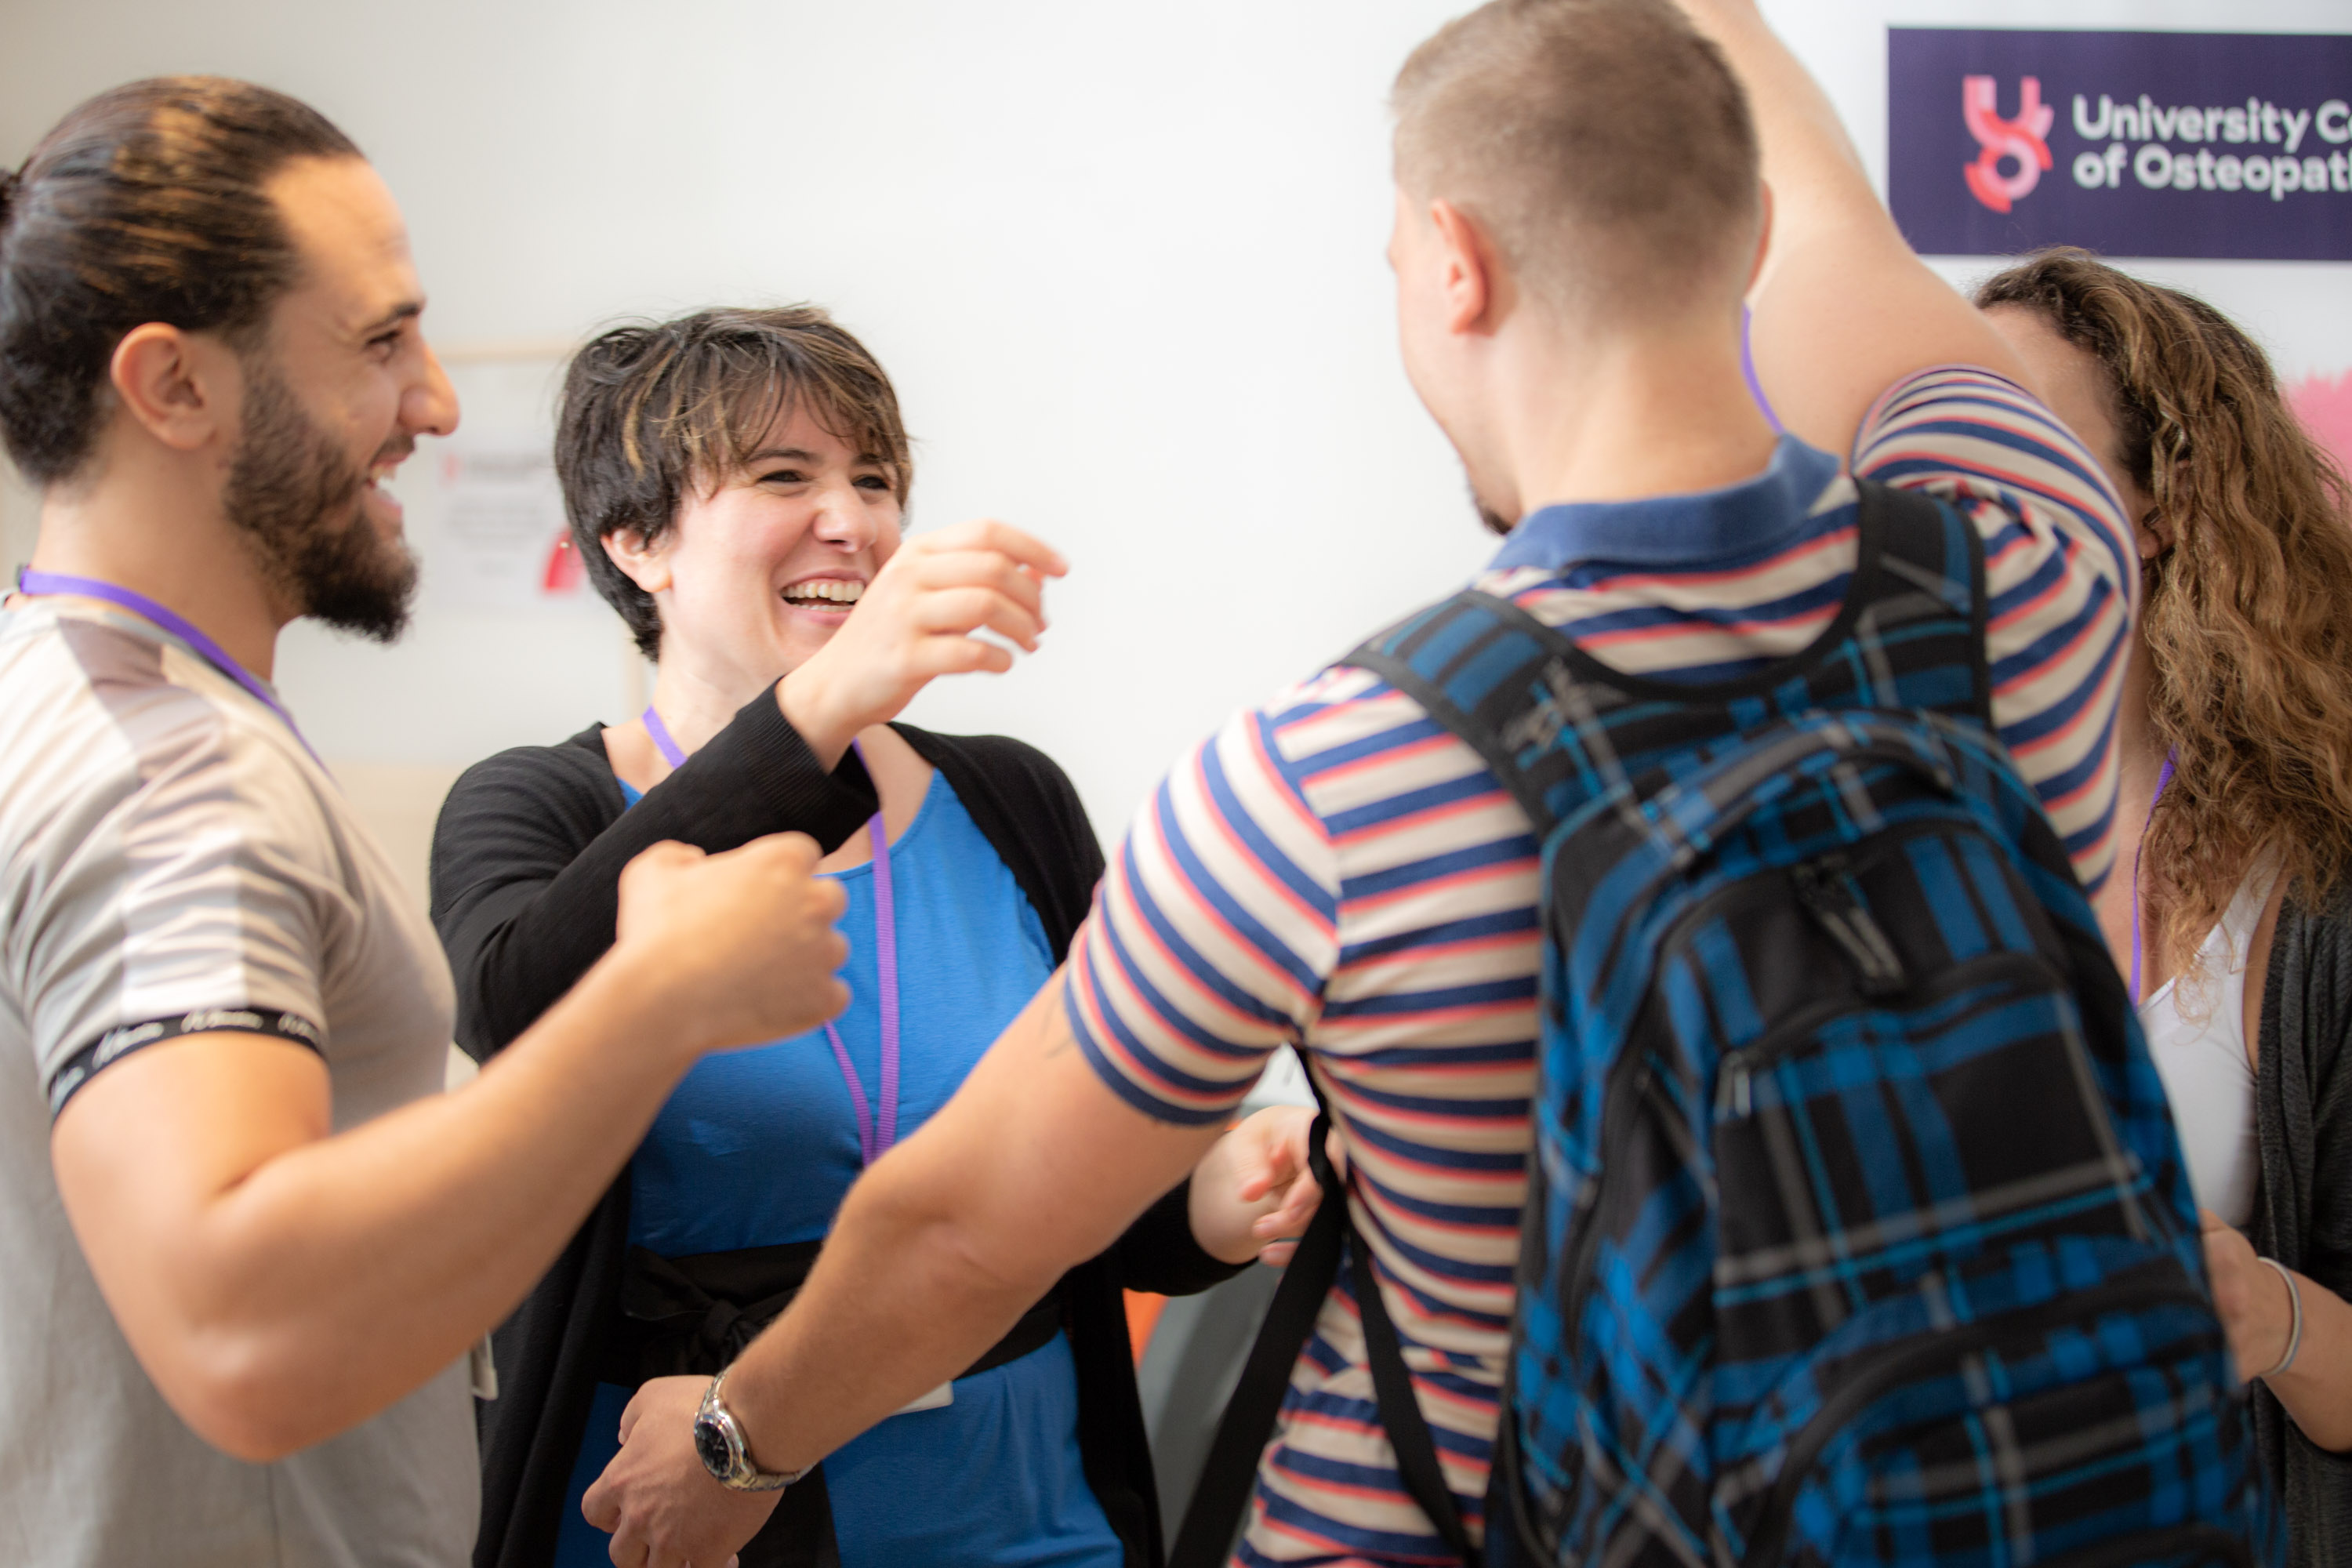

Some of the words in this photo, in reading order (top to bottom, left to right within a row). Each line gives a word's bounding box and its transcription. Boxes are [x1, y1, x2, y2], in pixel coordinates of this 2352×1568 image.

[2072, 93, 2311, 154] University
[2315, 99, 2352, 144] C
[2072, 142, 2128, 189] of
[2133, 143, 2352, 202] Osteopat
